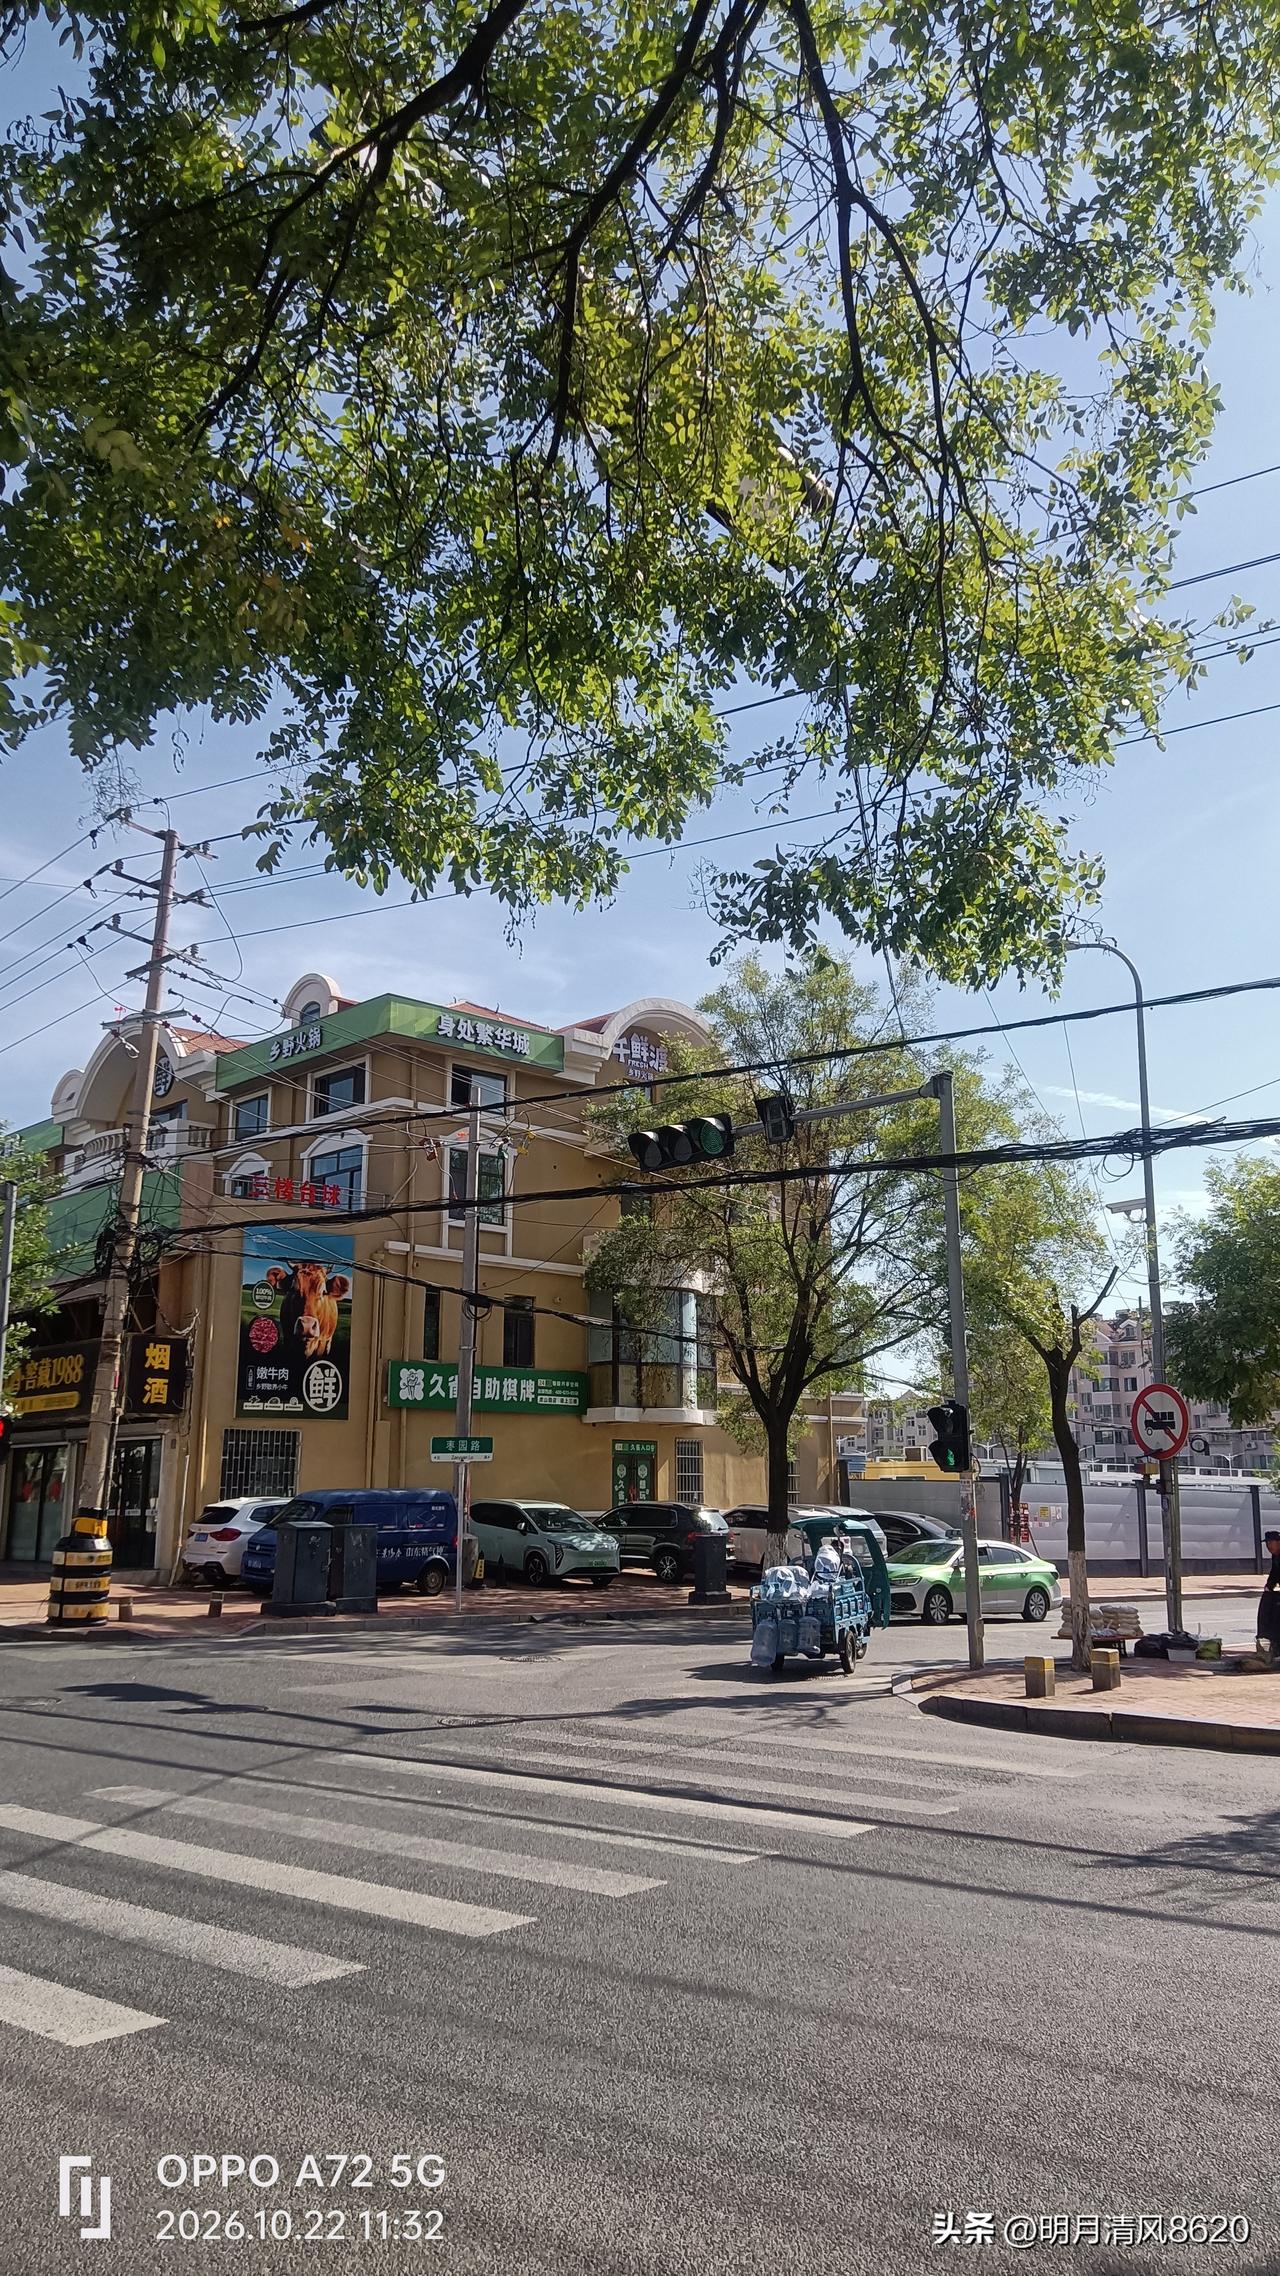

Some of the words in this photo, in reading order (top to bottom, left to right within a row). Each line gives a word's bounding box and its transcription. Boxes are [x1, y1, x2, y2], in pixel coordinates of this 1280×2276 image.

[269, 1026, 321, 1062] 乡野火锅
[437, 1012, 531, 1056] 身处繁华城
[627, 1059, 649, 1069] FRESH
[255, 1287, 272, 1295] 100%
[143, 1343, 171, 1404] 烟酒
[256, 1366, 289, 1381] 嫩牛肉
[308, 1365, 337, 1408] 鲜
[445, 1440, 481, 1452] 枣园路
